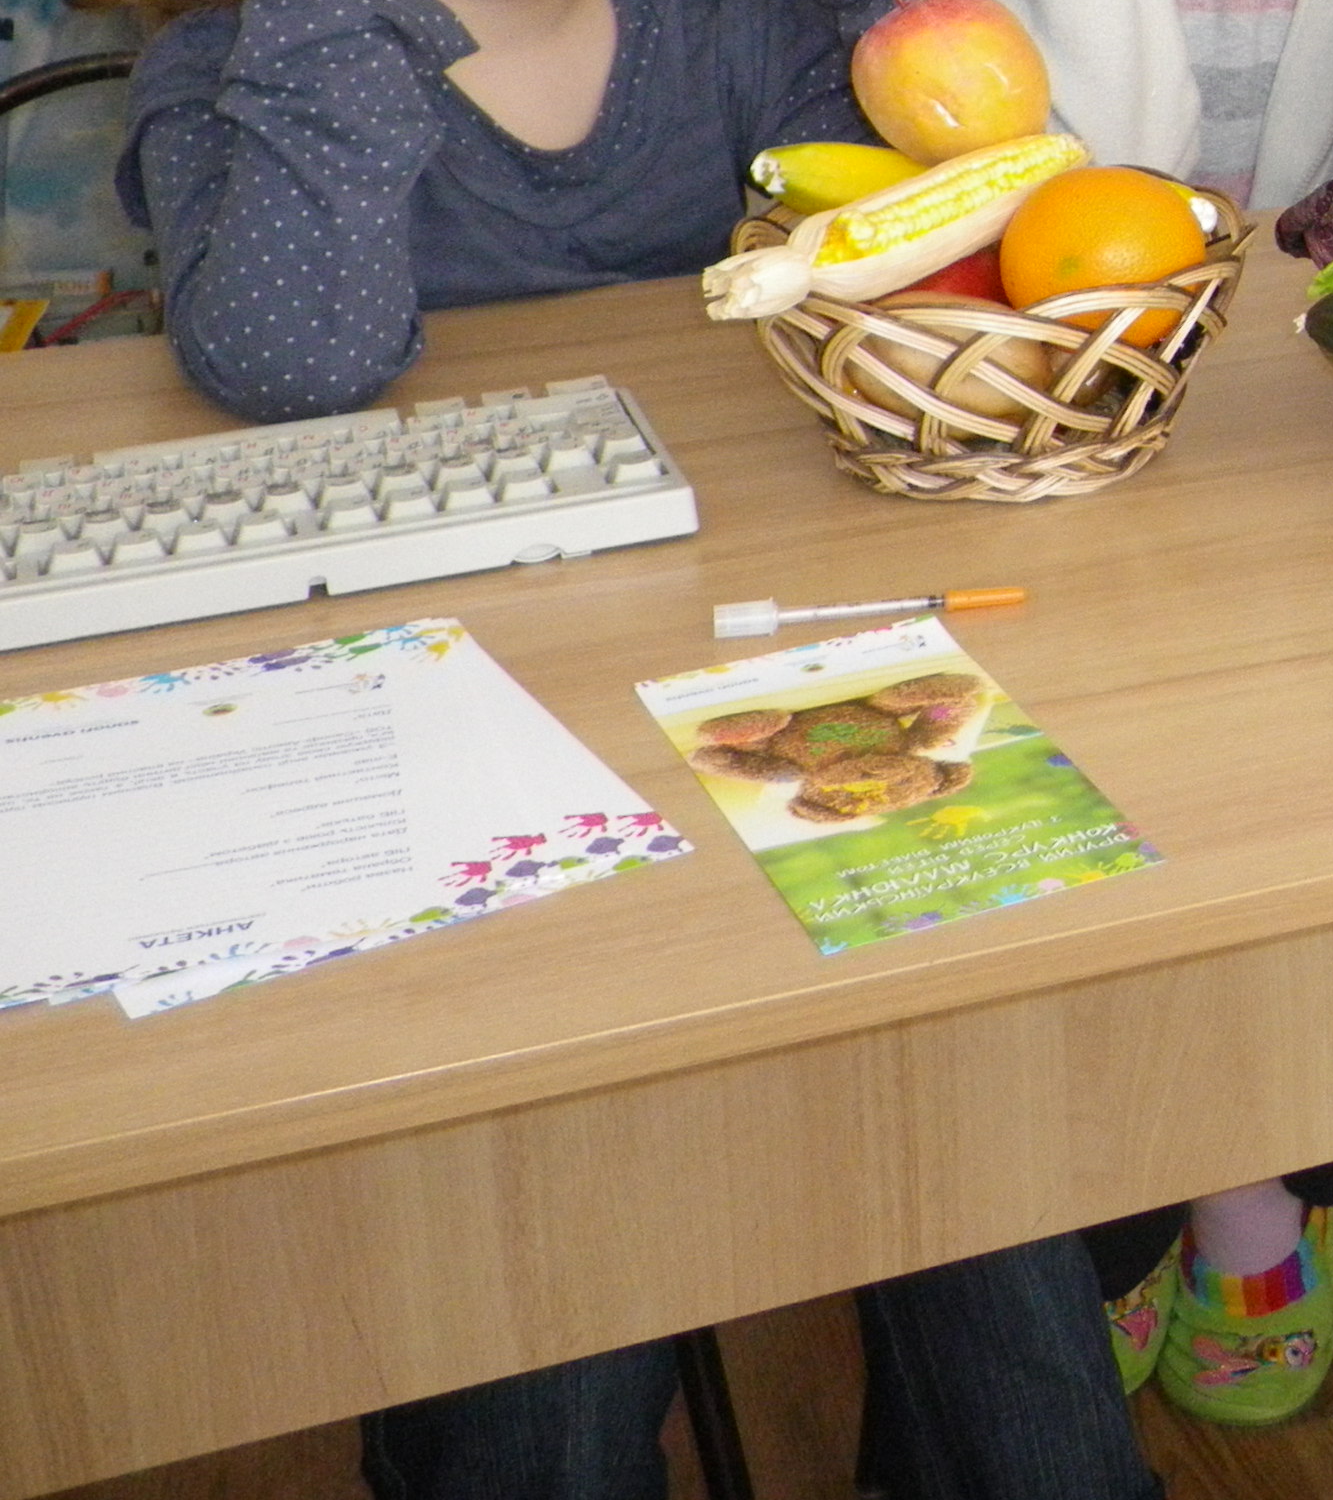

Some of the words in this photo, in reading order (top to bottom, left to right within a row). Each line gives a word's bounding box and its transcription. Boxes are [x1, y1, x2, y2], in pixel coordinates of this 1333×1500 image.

[5, 730, 76, 745] aventis
[80, 720, 140, 734] sanofi
[958, 835, 1026, 856] СЕРЕД
[984, 823, 1119, 864] КОНКУРС
[809, 860, 971, 911] МАЛЮНКА
[138, 921, 255, 950] АНКЕТА
